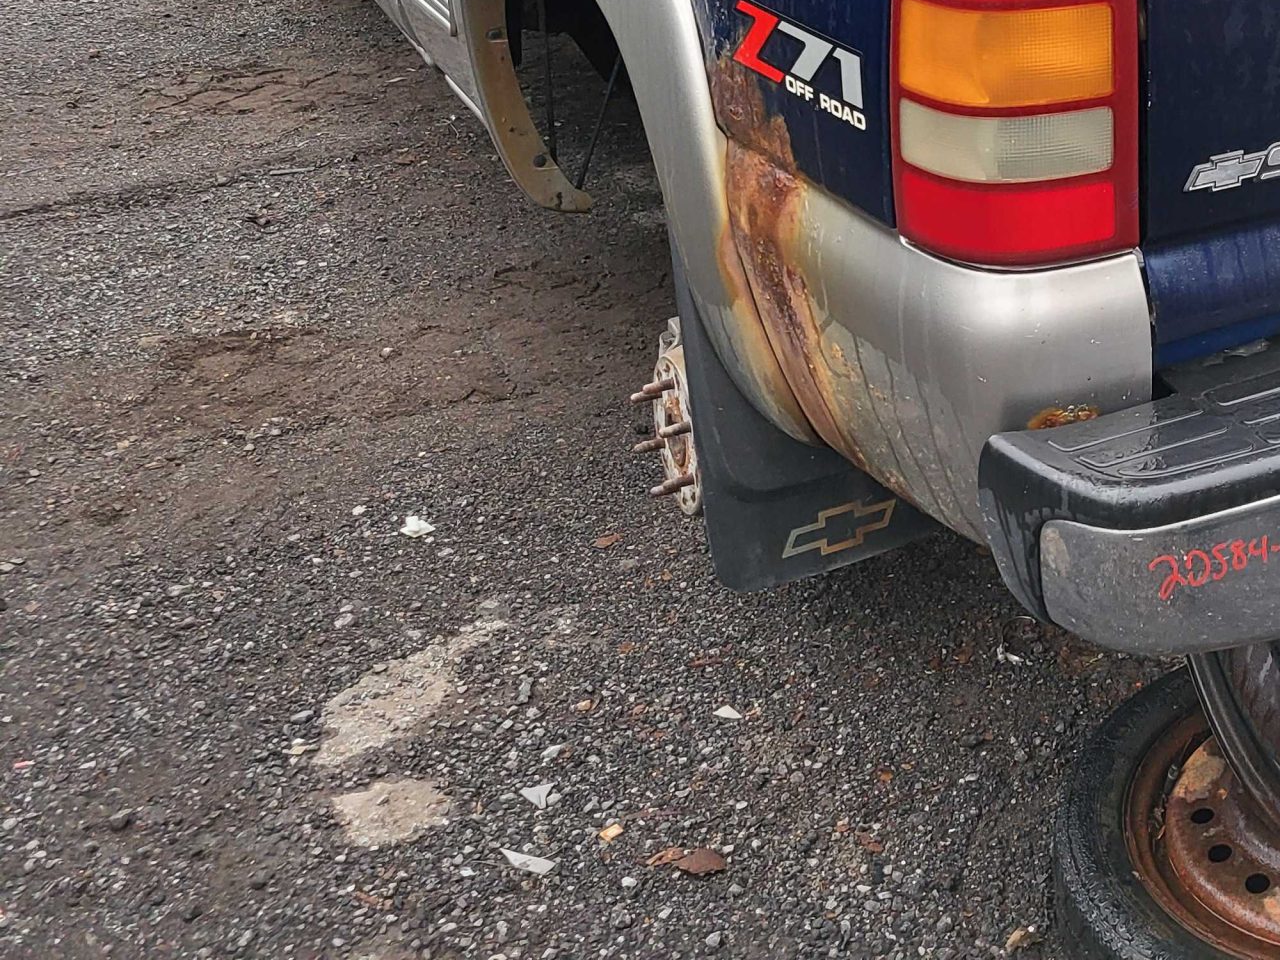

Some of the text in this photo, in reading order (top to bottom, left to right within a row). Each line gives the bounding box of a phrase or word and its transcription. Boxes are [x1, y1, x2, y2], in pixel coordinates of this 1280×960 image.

[733, 0, 863, 109] Z71
[785, 75, 867, 131] OFF ROAD
